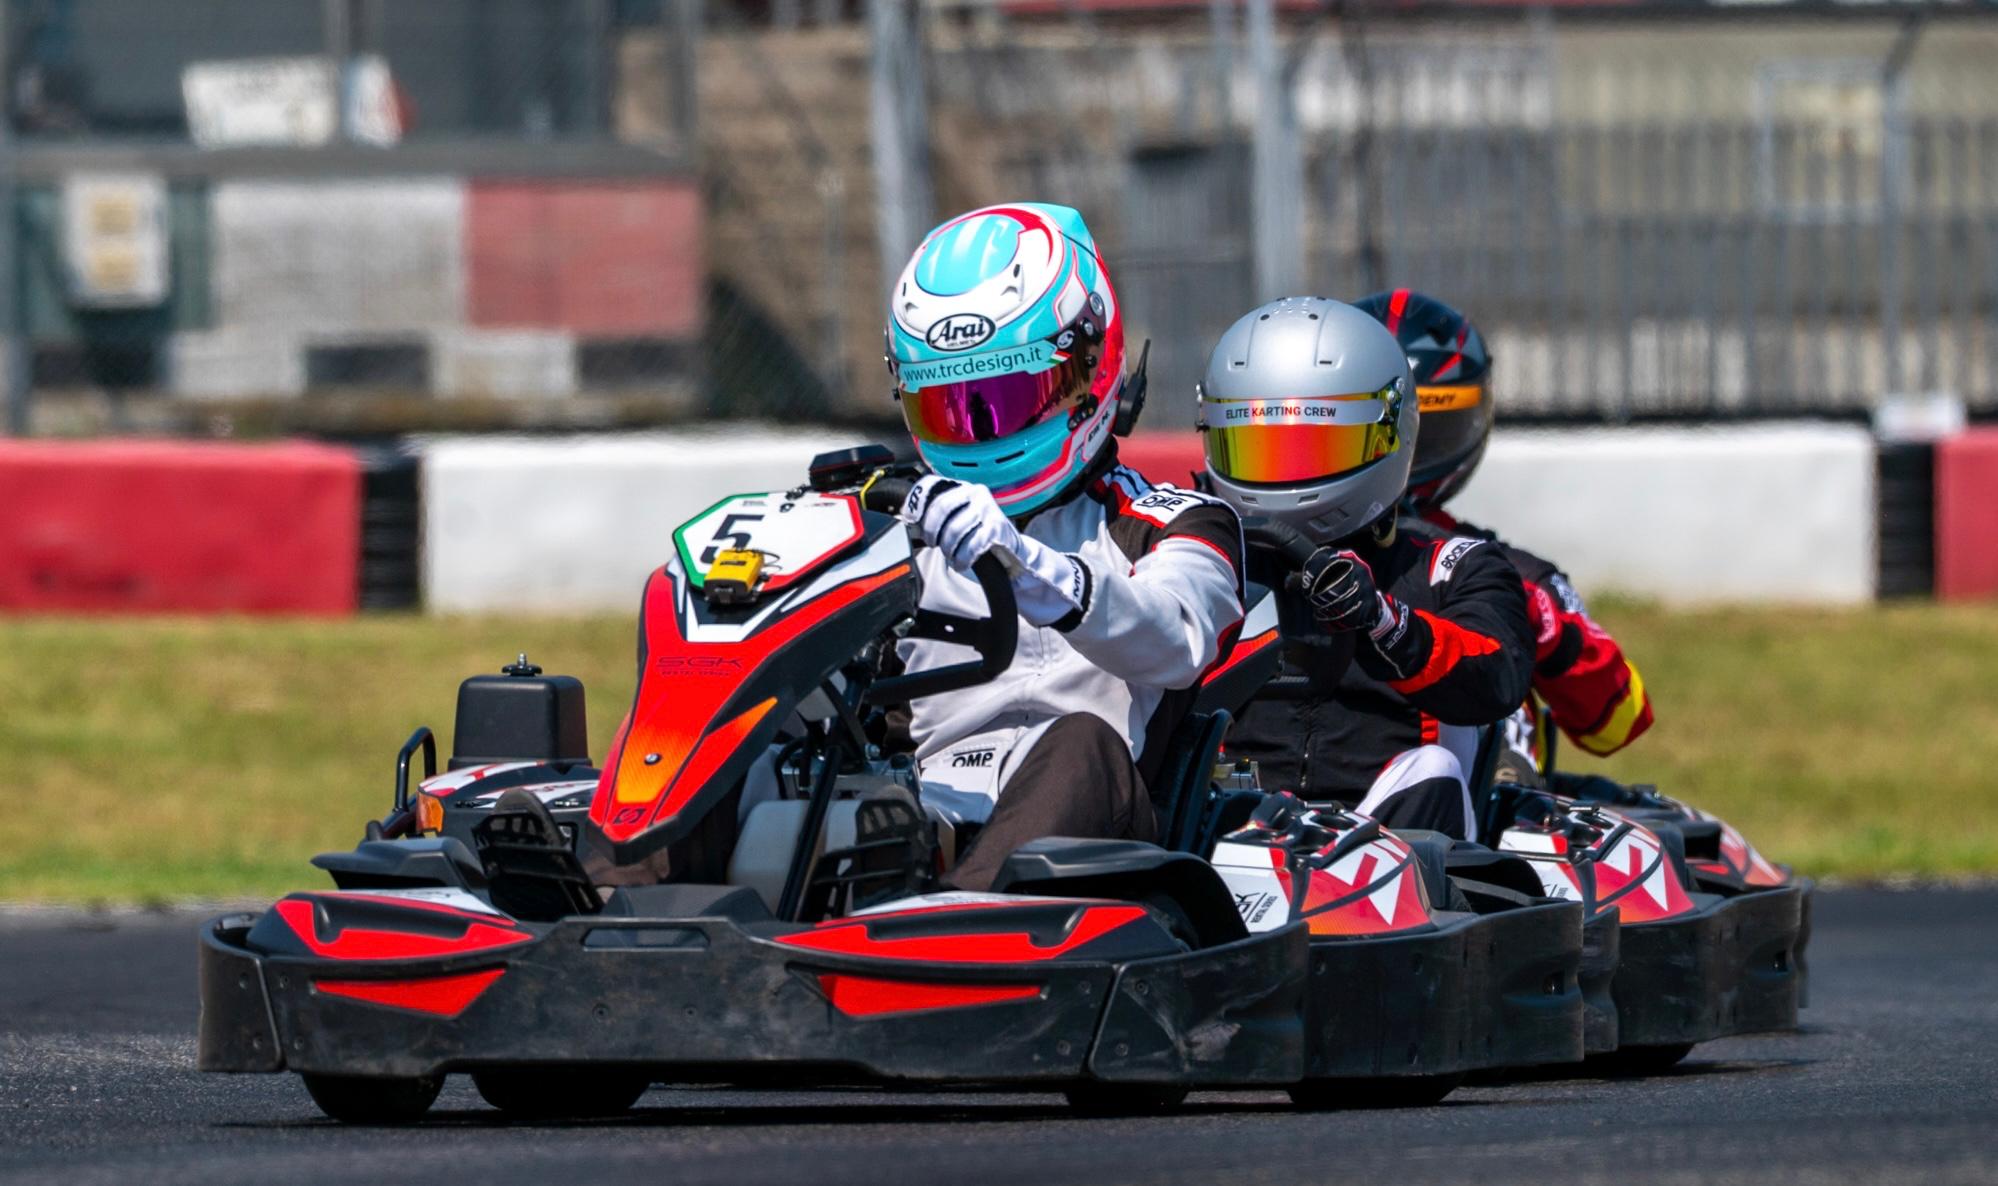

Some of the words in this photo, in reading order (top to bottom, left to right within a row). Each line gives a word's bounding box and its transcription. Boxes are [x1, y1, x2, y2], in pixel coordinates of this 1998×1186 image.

[934, 318, 987, 344] Arai
[904, 347, 1042, 381] www.trcdesign.it
[1226, 408, 1249, 419] ELITE
[1251, 406, 1301, 417] KARTING
[1304, 406, 1337, 417] CREW
[700, 514, 765, 565] 5
[656, 656, 742, 669] SGK
